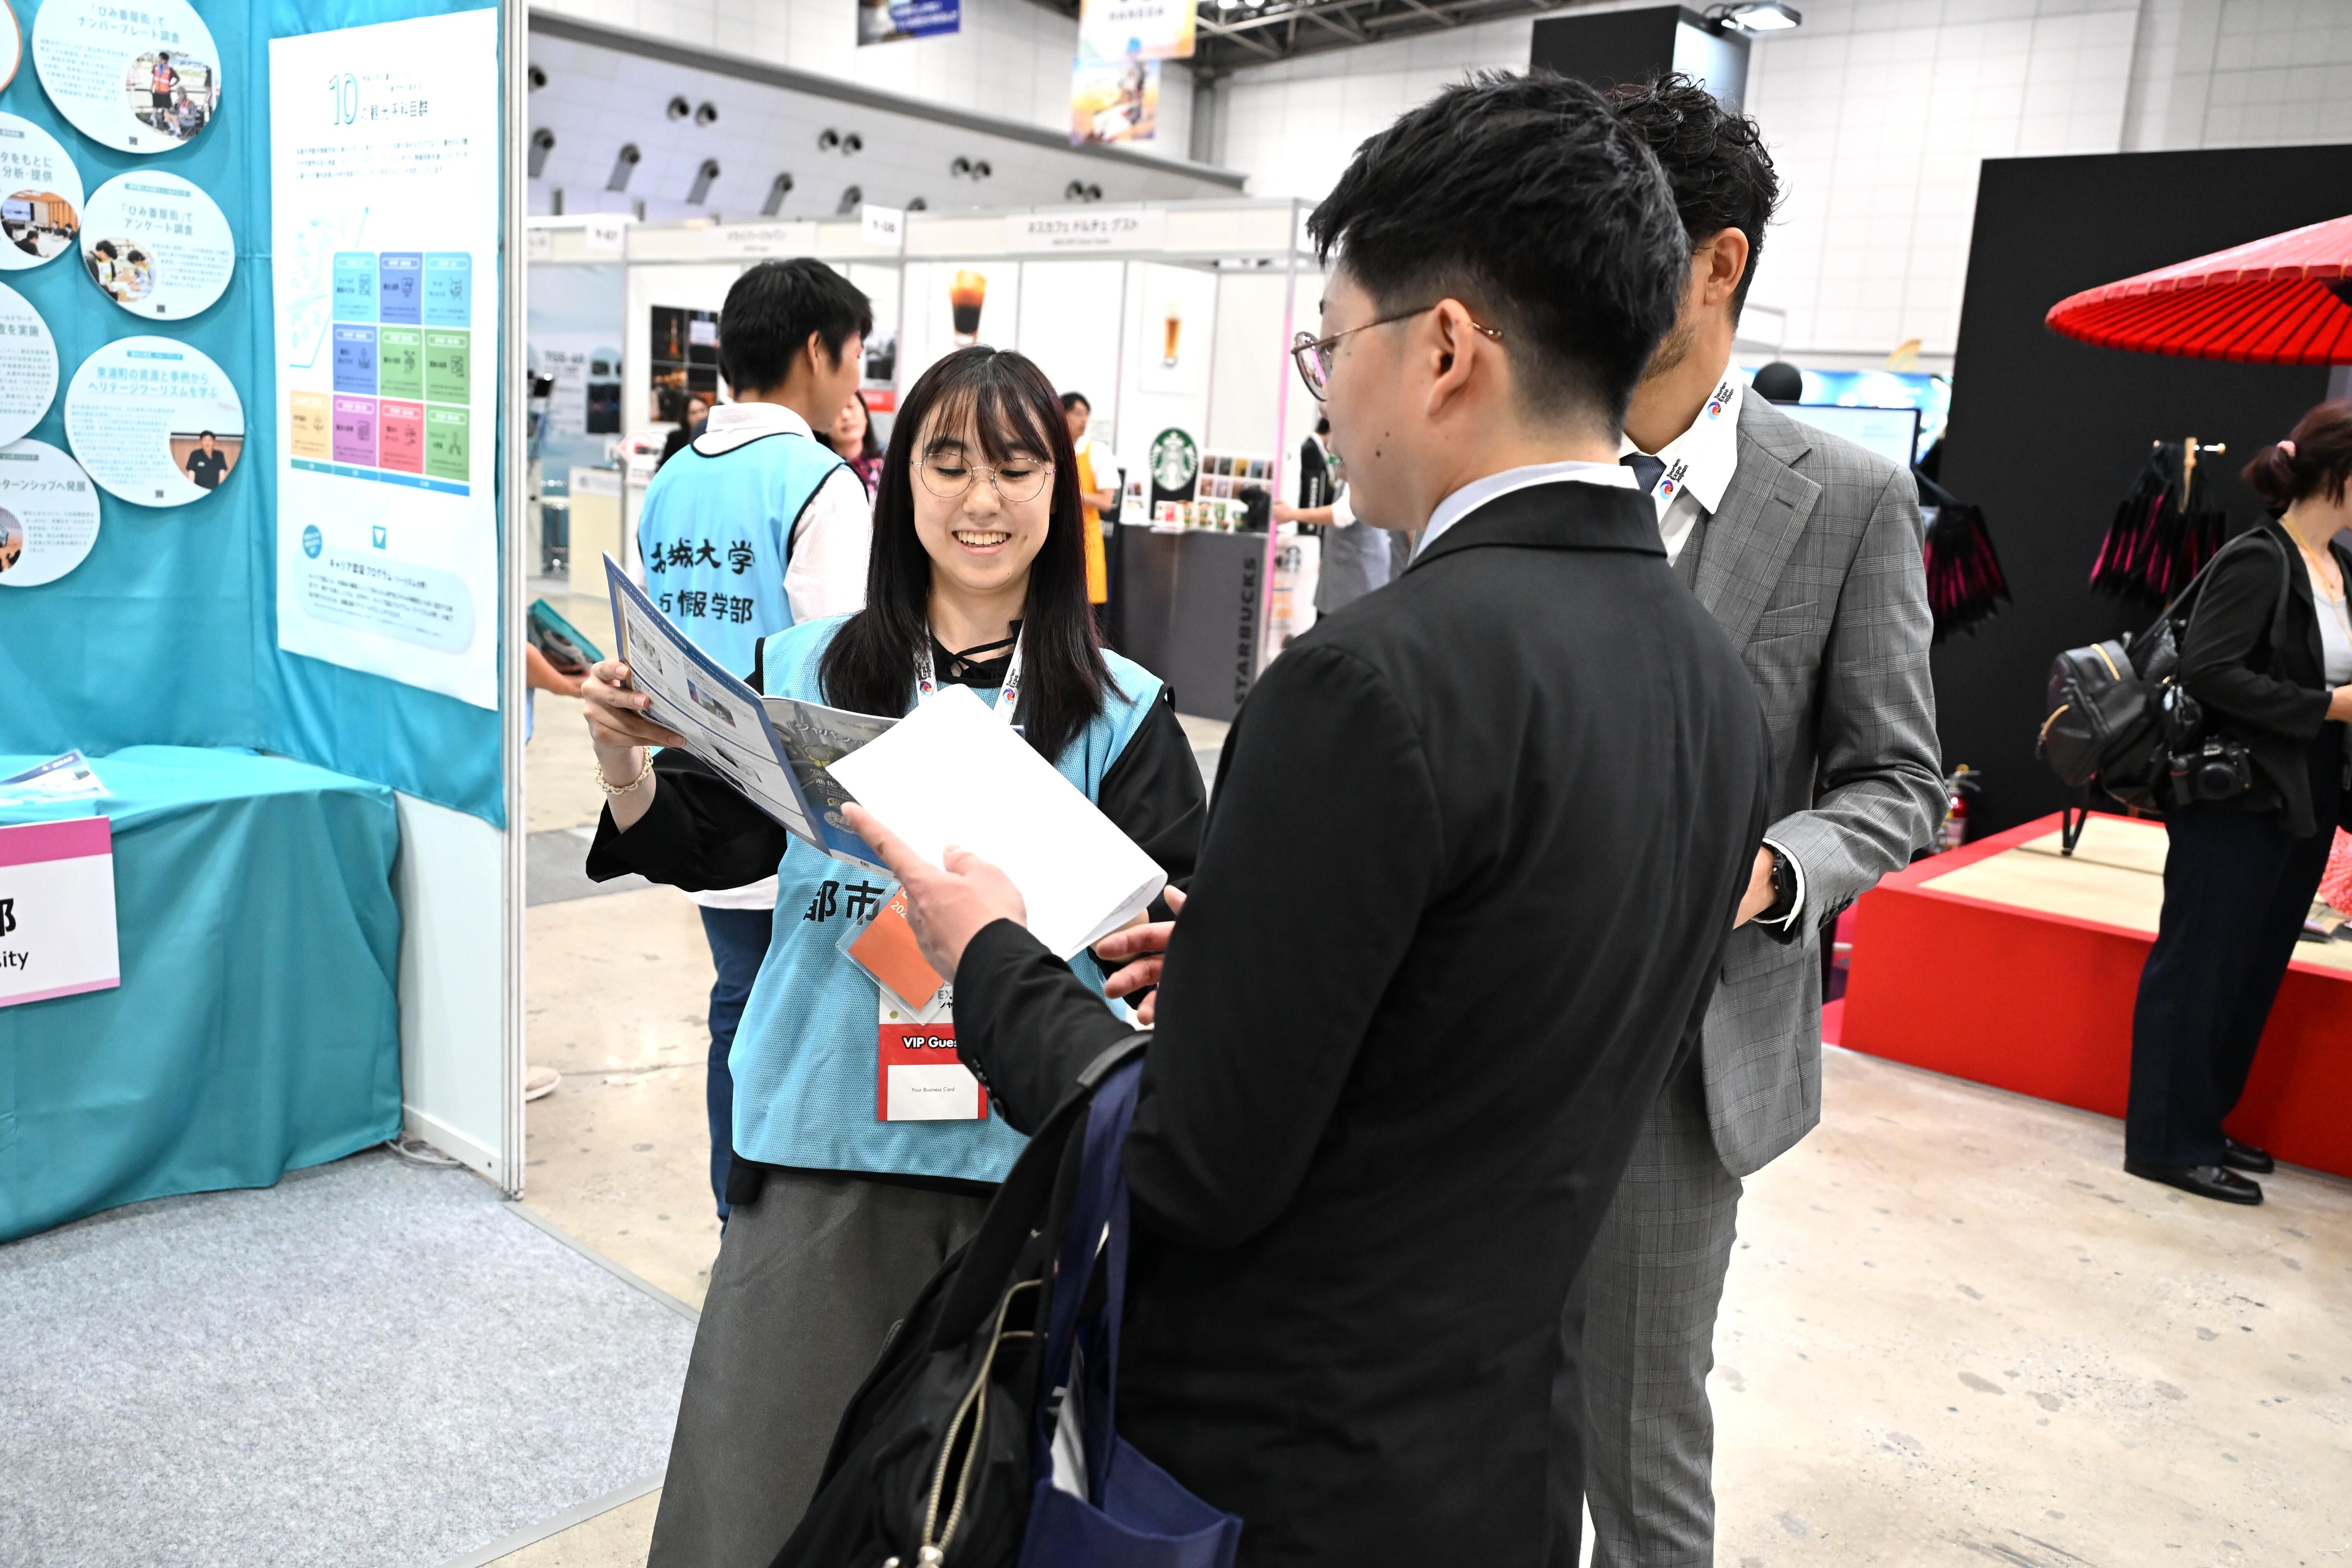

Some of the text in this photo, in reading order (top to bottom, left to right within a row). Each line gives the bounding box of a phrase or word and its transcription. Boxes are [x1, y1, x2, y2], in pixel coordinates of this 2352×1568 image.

[1714, 382, 1727, 399] Tourism
[1718, 389, 1729, 402] Expo
[1723, 388, 1734, 405] Japan
[1666, 458, 1681, 478] Tourism
[1670, 466, 1682, 481] Expo
[1675, 465, 1689, 483] Japan
[1234, 557, 1256, 704] STARBUCKS
[1006, 668, 1016, 687] Tourism
[1010, 675, 1019, 688] Expo
[0, 951, 29, 970] ity
[902, 1036, 926, 1049] VIP
